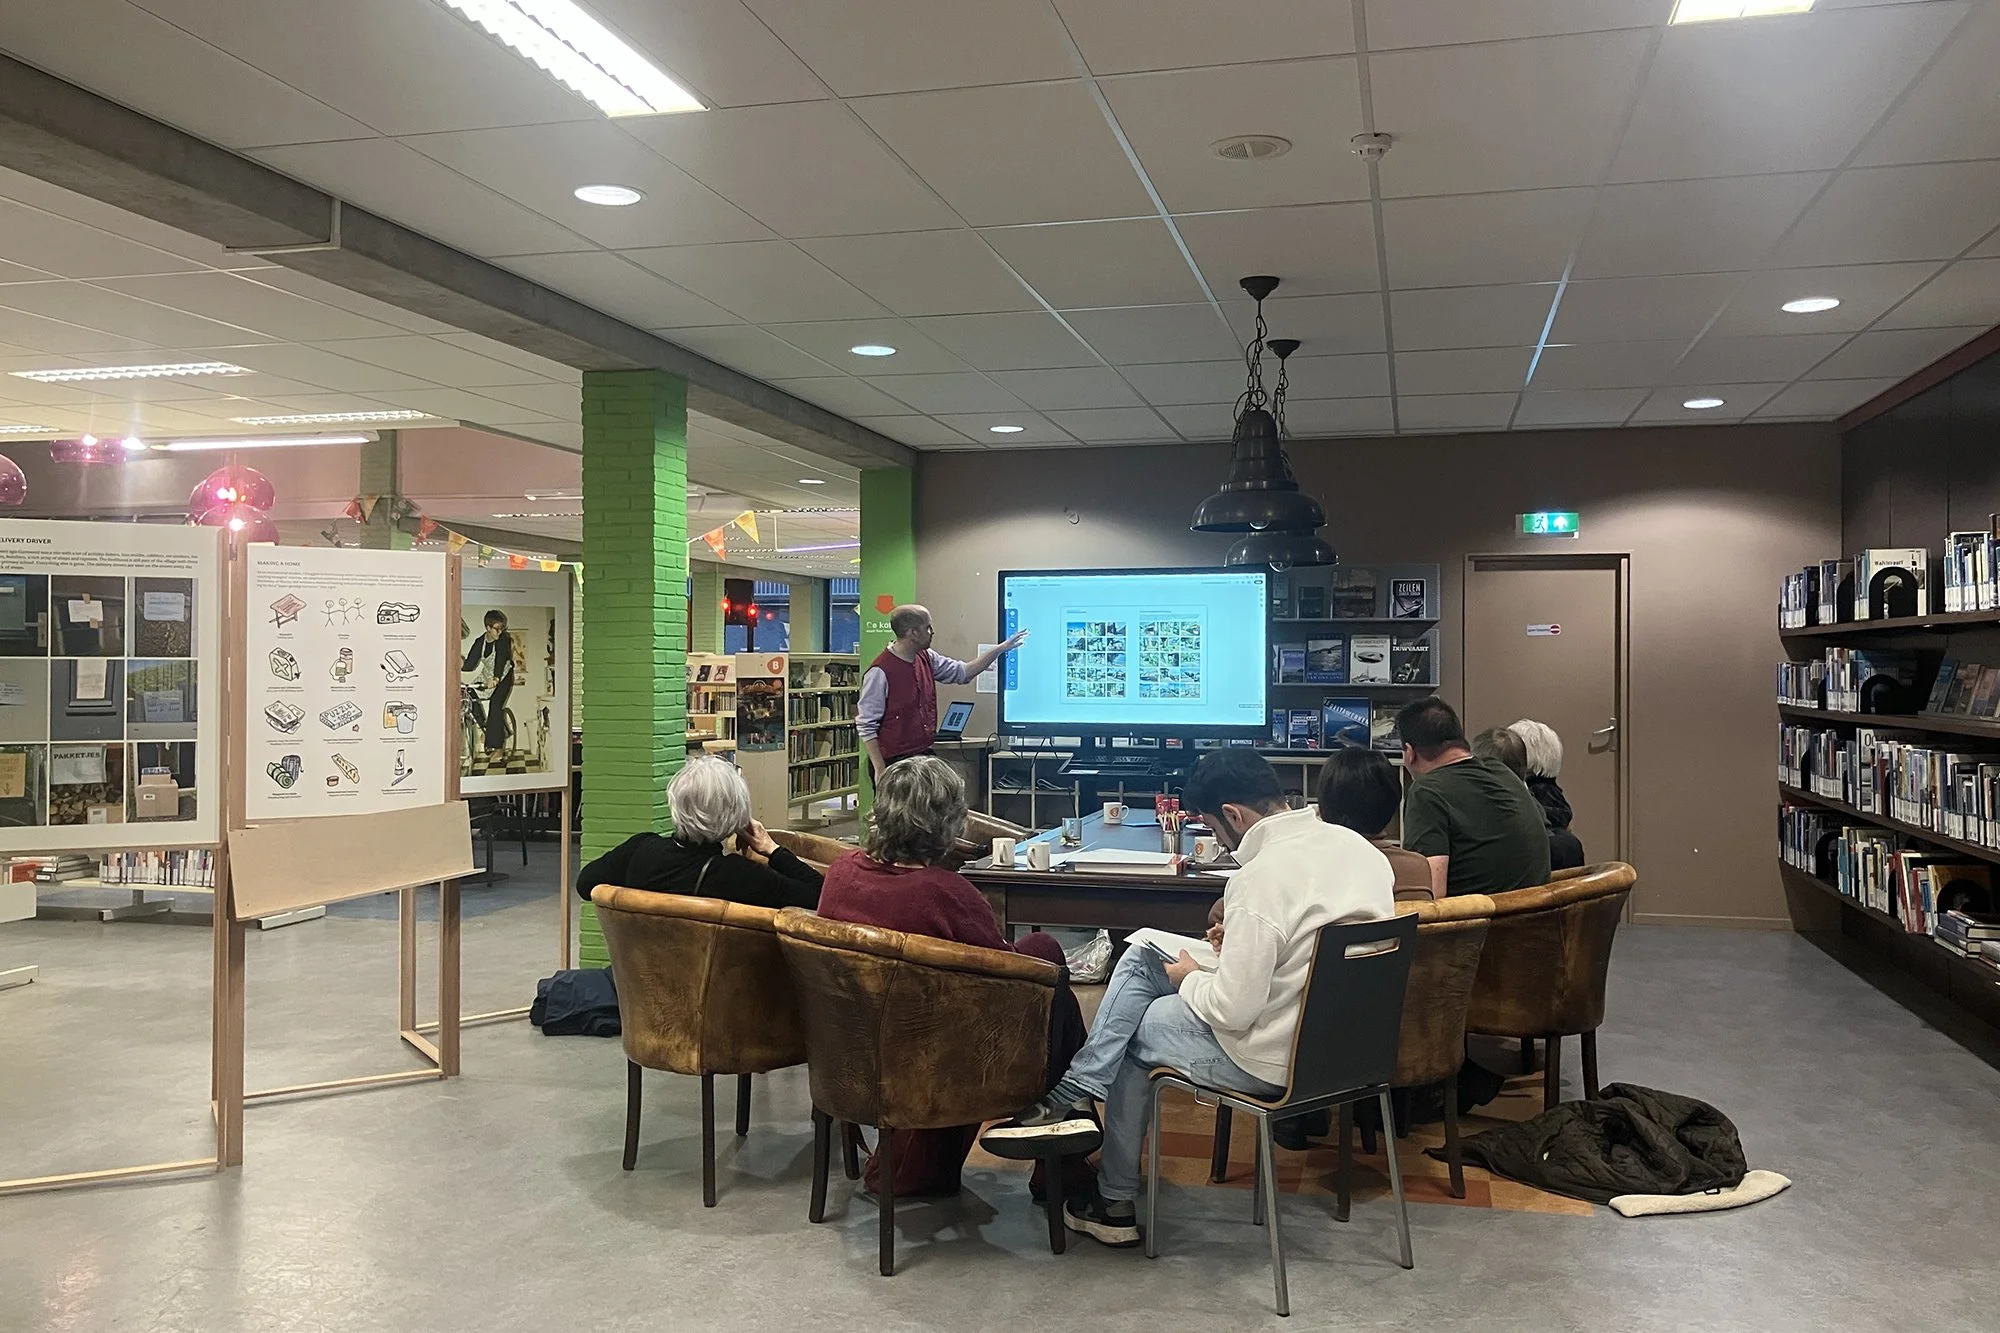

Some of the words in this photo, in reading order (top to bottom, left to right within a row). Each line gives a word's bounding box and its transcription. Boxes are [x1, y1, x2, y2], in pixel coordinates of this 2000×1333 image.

[1399, 583, 1421, 592] ZEILEN
[772, 661, 780, 670] B
[323, 703, 353, 718] PUZZLE
[53, 752, 101, 760] PAKKETJES
